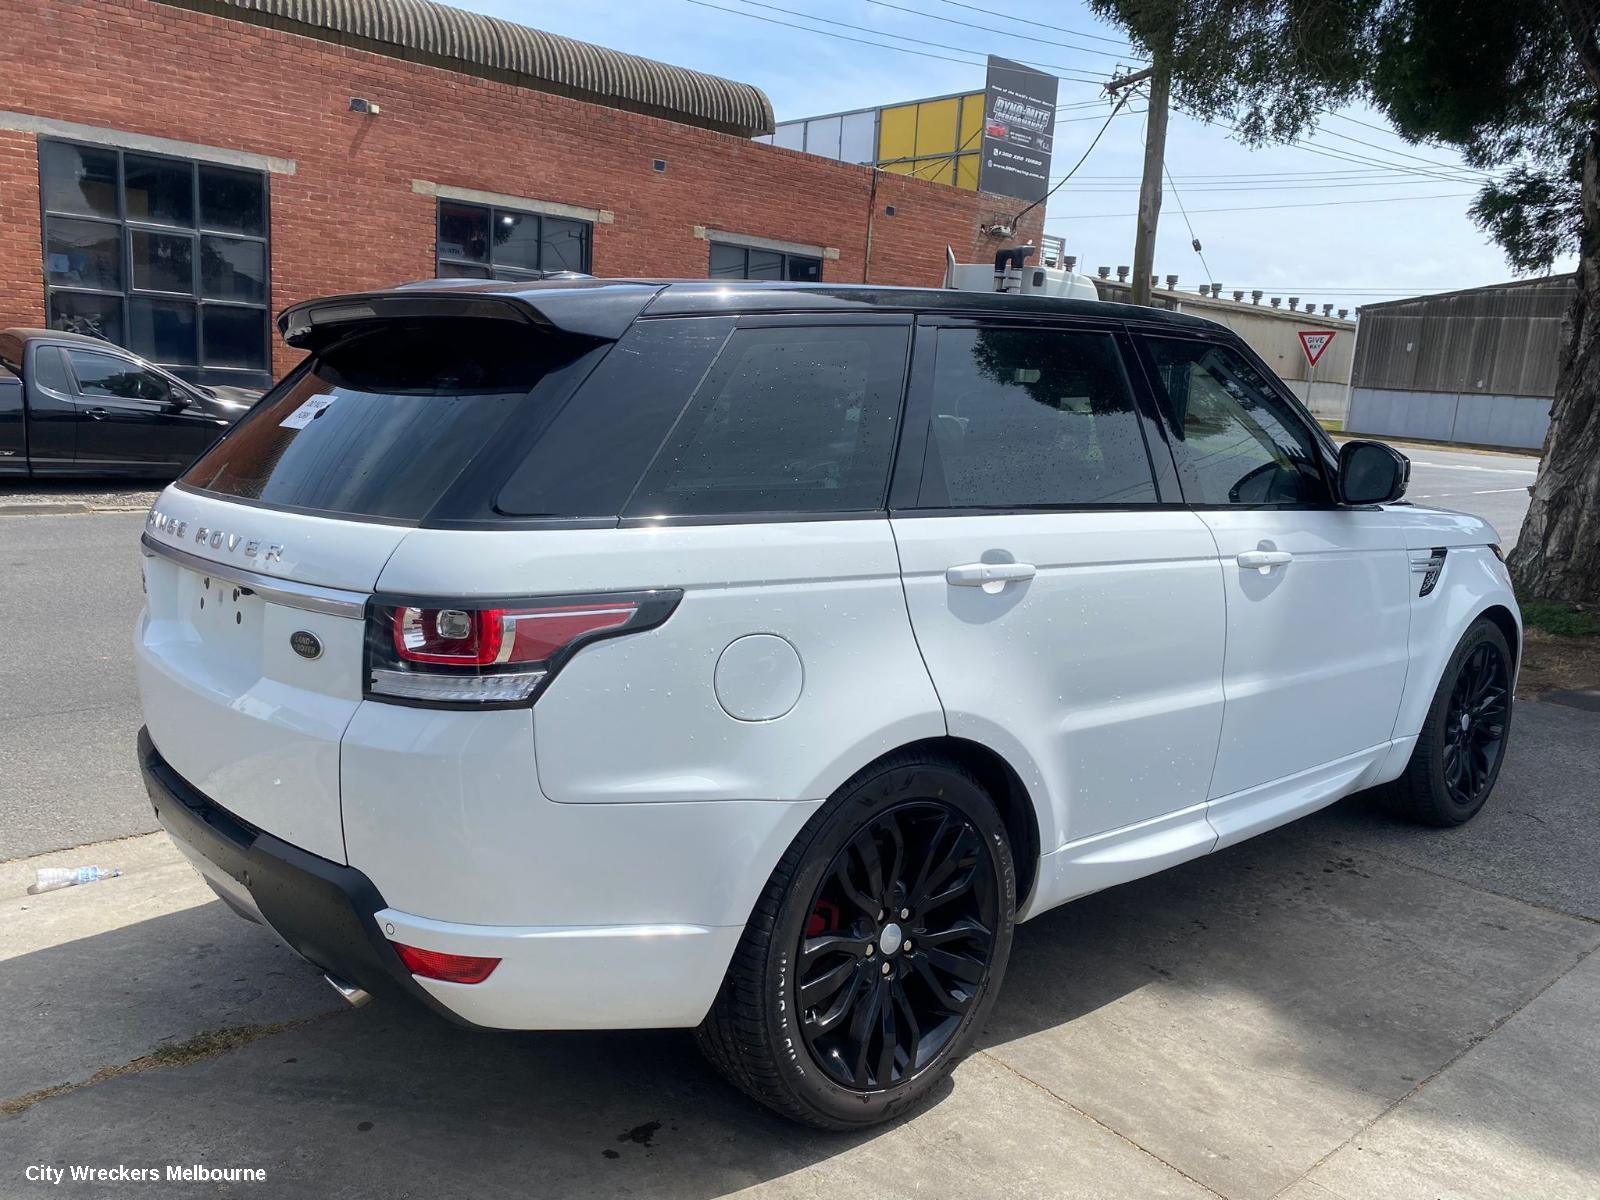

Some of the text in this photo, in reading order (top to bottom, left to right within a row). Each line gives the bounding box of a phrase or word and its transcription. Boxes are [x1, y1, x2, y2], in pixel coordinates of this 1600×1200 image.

[1307, 336, 1325, 344] GIVE
[148, 510, 284, 563] ANGE ROVER
